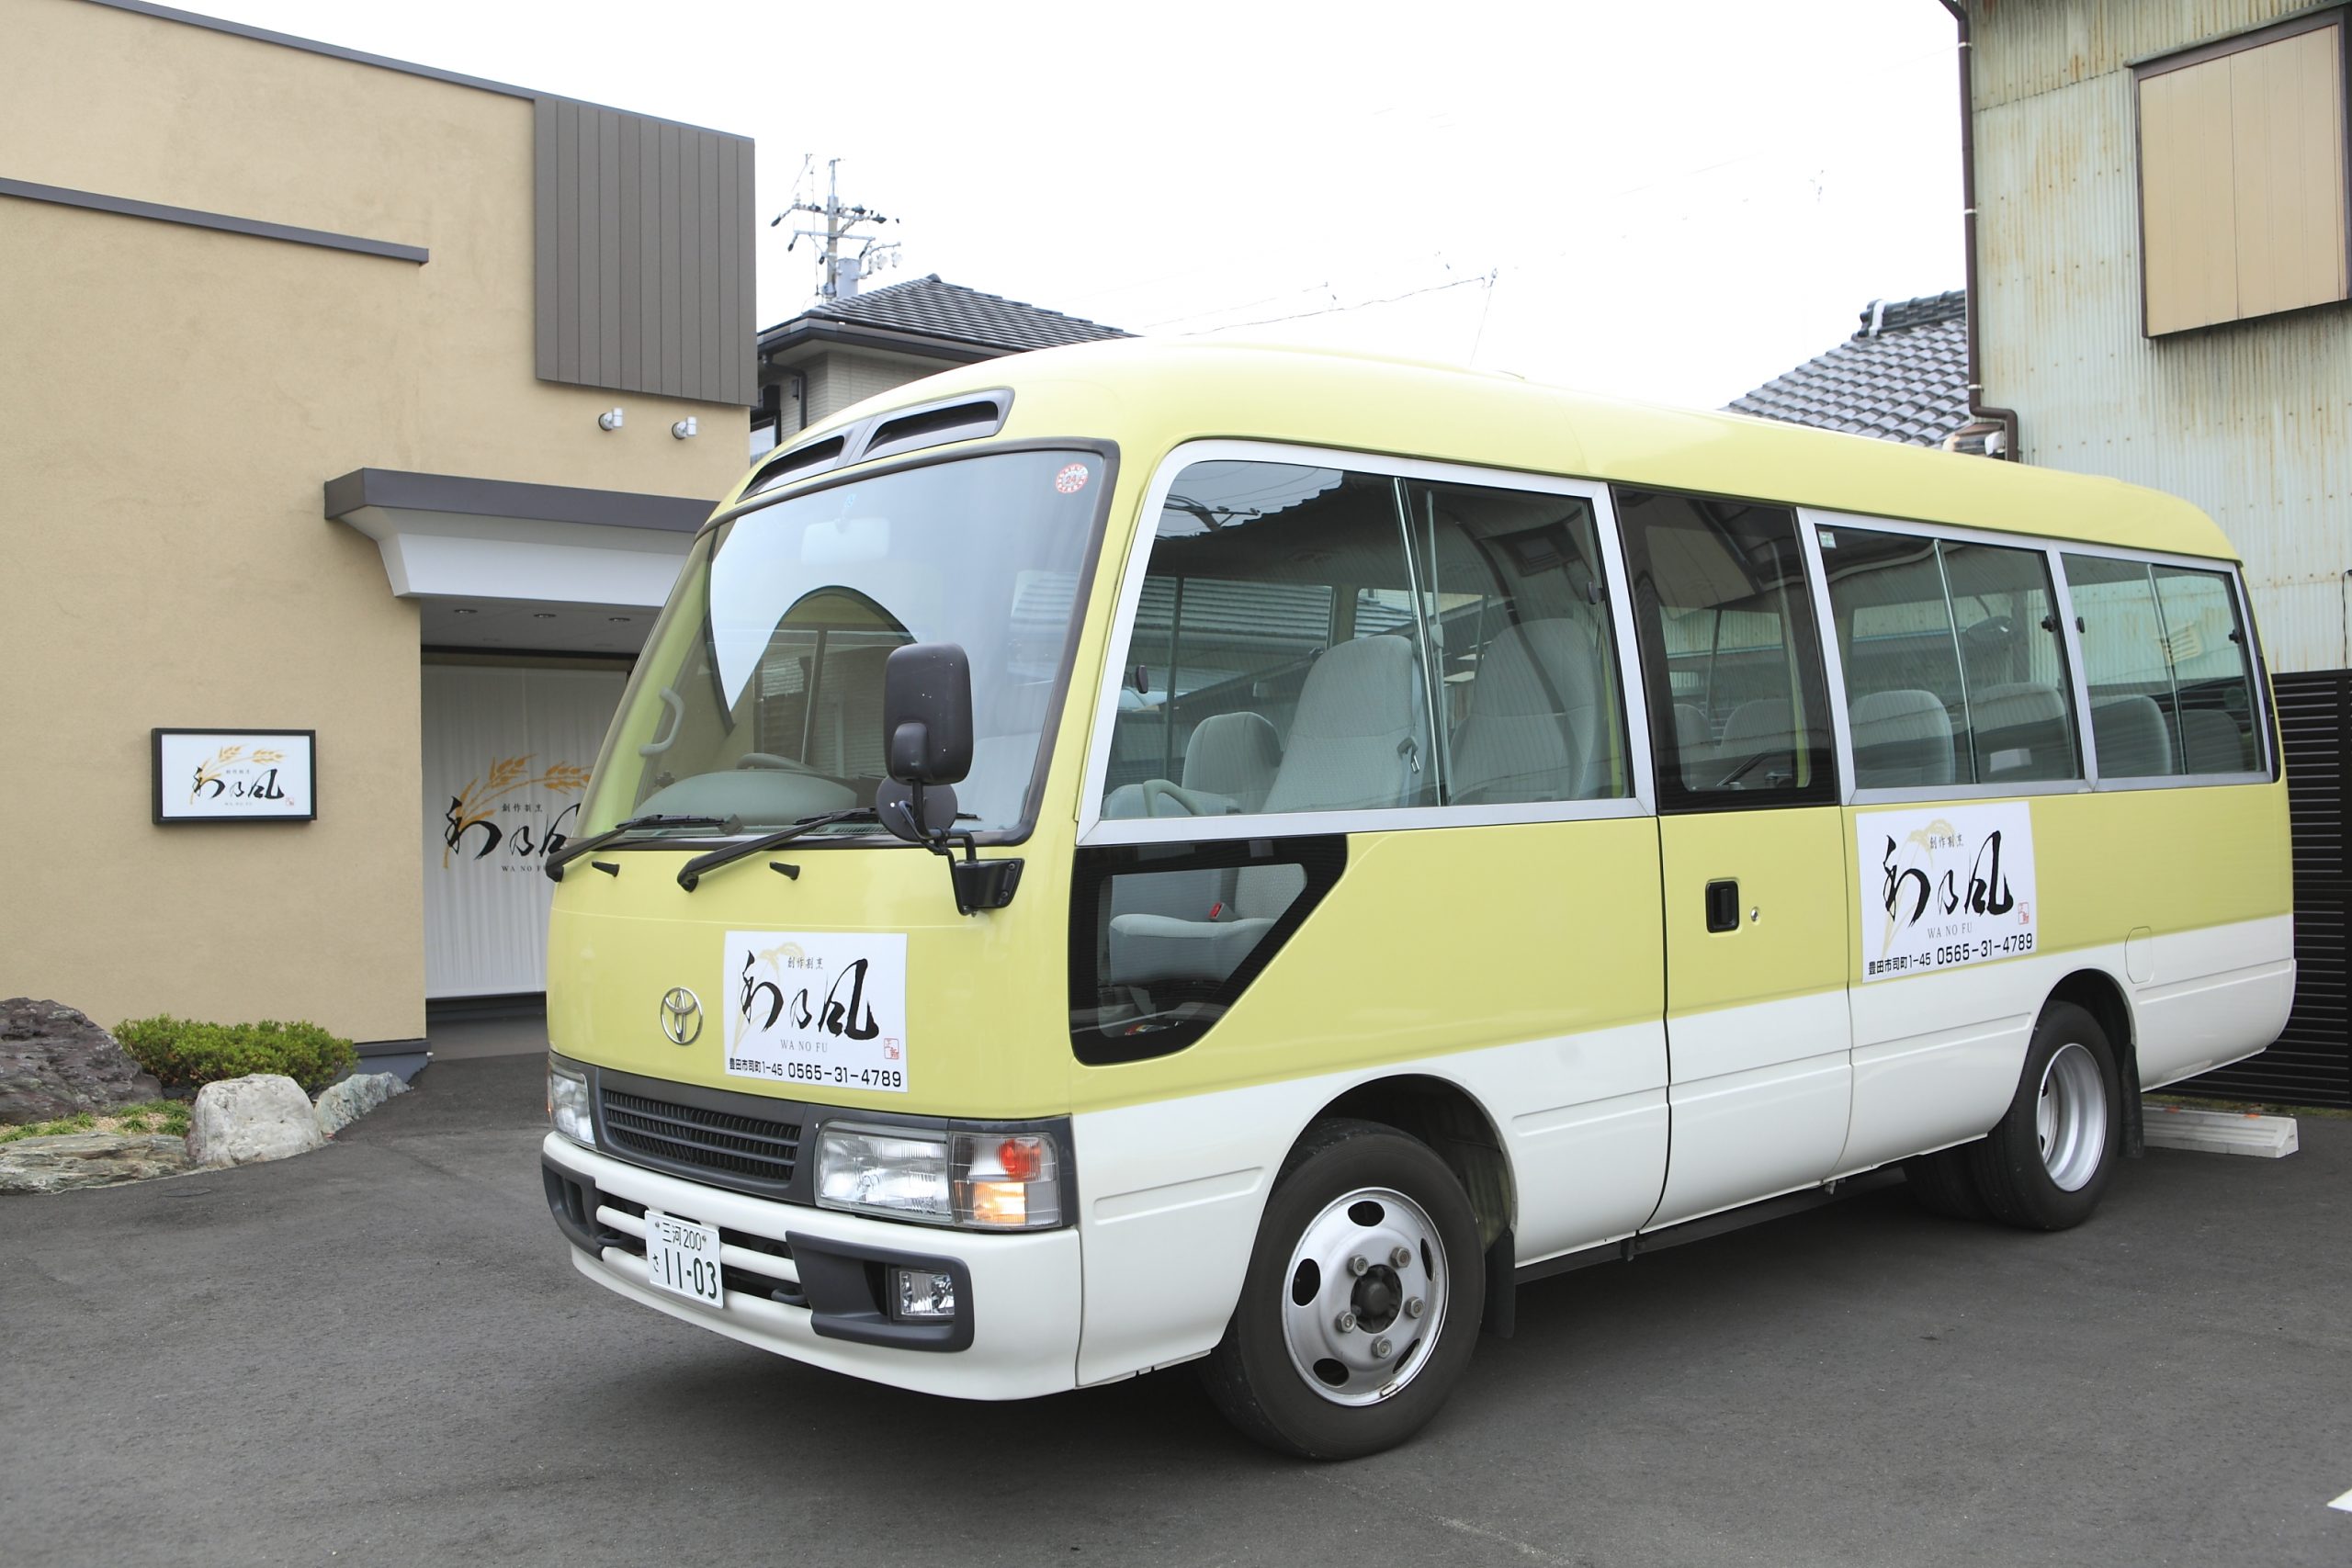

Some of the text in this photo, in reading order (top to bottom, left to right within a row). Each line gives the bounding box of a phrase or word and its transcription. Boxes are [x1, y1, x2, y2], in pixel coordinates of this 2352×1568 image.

[1928, 922, 1973, 939] WA NO FU
[1937, 932, 2033, 965] 0565-31-4789
[780, 1039, 828, 1054] WA NO FU
[787, 1062, 901, 1088] 0565-31-4789
[652, 1247, 718, 1300] さ 11-03
